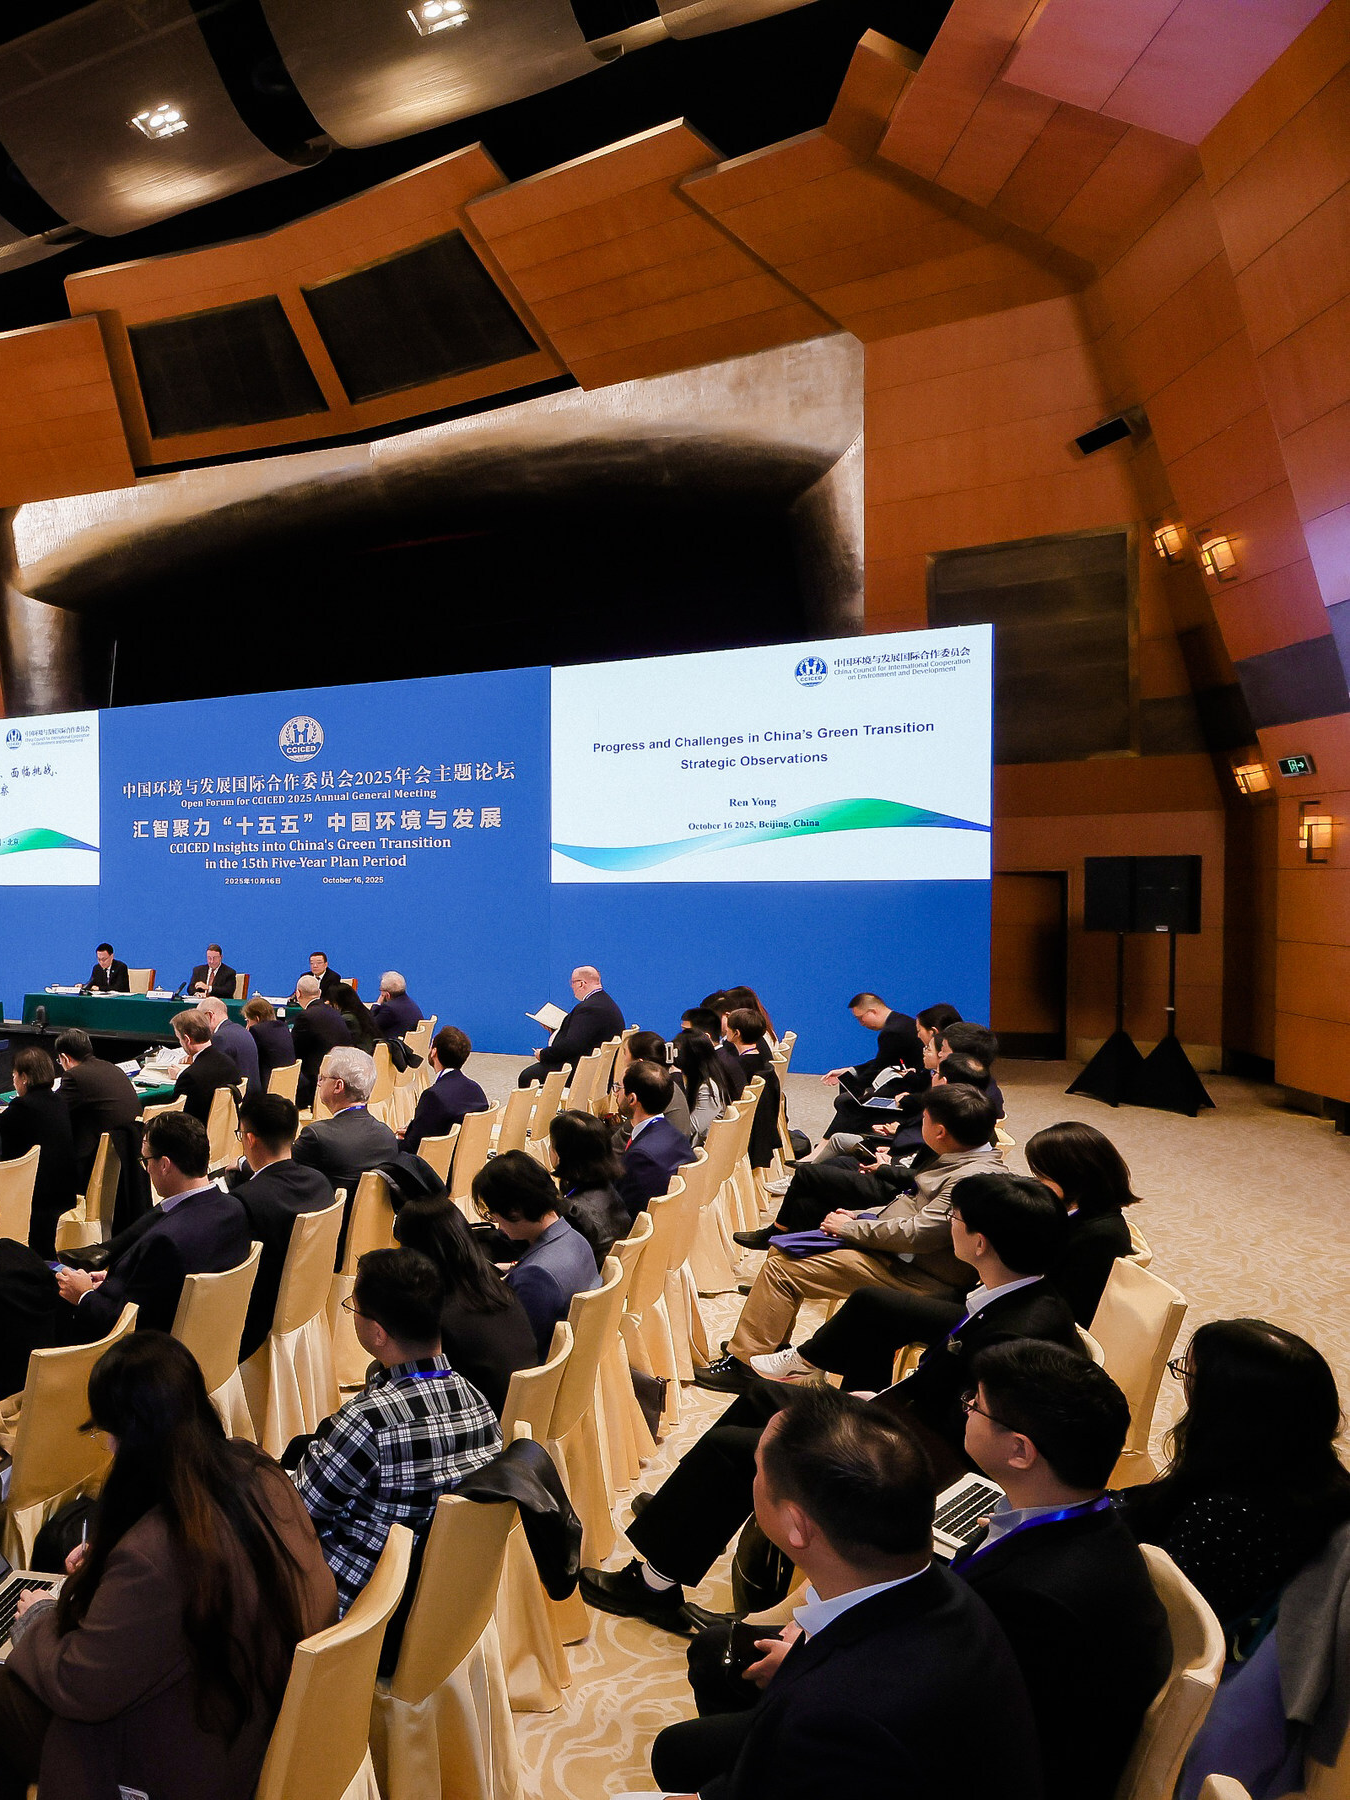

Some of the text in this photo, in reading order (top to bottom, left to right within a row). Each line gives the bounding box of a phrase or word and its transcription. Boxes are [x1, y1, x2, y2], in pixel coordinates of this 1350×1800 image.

[834, 646, 971, 667] 中国环境与发展国际合作委员会
[853, 666, 876, 674] Council
[889, 661, 929, 670] International
[931, 658, 971, 668] Cooperation
[912, 665, 956, 676] Development
[593, 742, 645, 754] Progress
[649, 739, 671, 749] and
[674, 735, 744, 748] Challenges
[748, 733, 760, 743] in
[817, 727, 858, 739] Green
[863, 721, 935, 736] Transition
[287, 745, 316, 754] CCICED
[680, 752, 828, 771] Strategic Observations
[122, 761, 516, 799] 中国环境与发展国际合作委员会2025年会主题论坛
[181, 788, 437, 809] Open Forum for CCICED 2025 Annual General Meeting
[729, 797, 777, 808] Ren Yong
[688, 822, 721, 830] October
[734, 821, 757, 830] 2025,
[793, 819, 820, 828] China
[169, 836, 451, 855] CCICED Insights into China's Green Transition
[205, 854, 407, 869] in the 15th Five-Year Plan Period
[224, 877, 282, 885] 2025年10月16日
[322, 876, 384, 885] October 16, 2025
